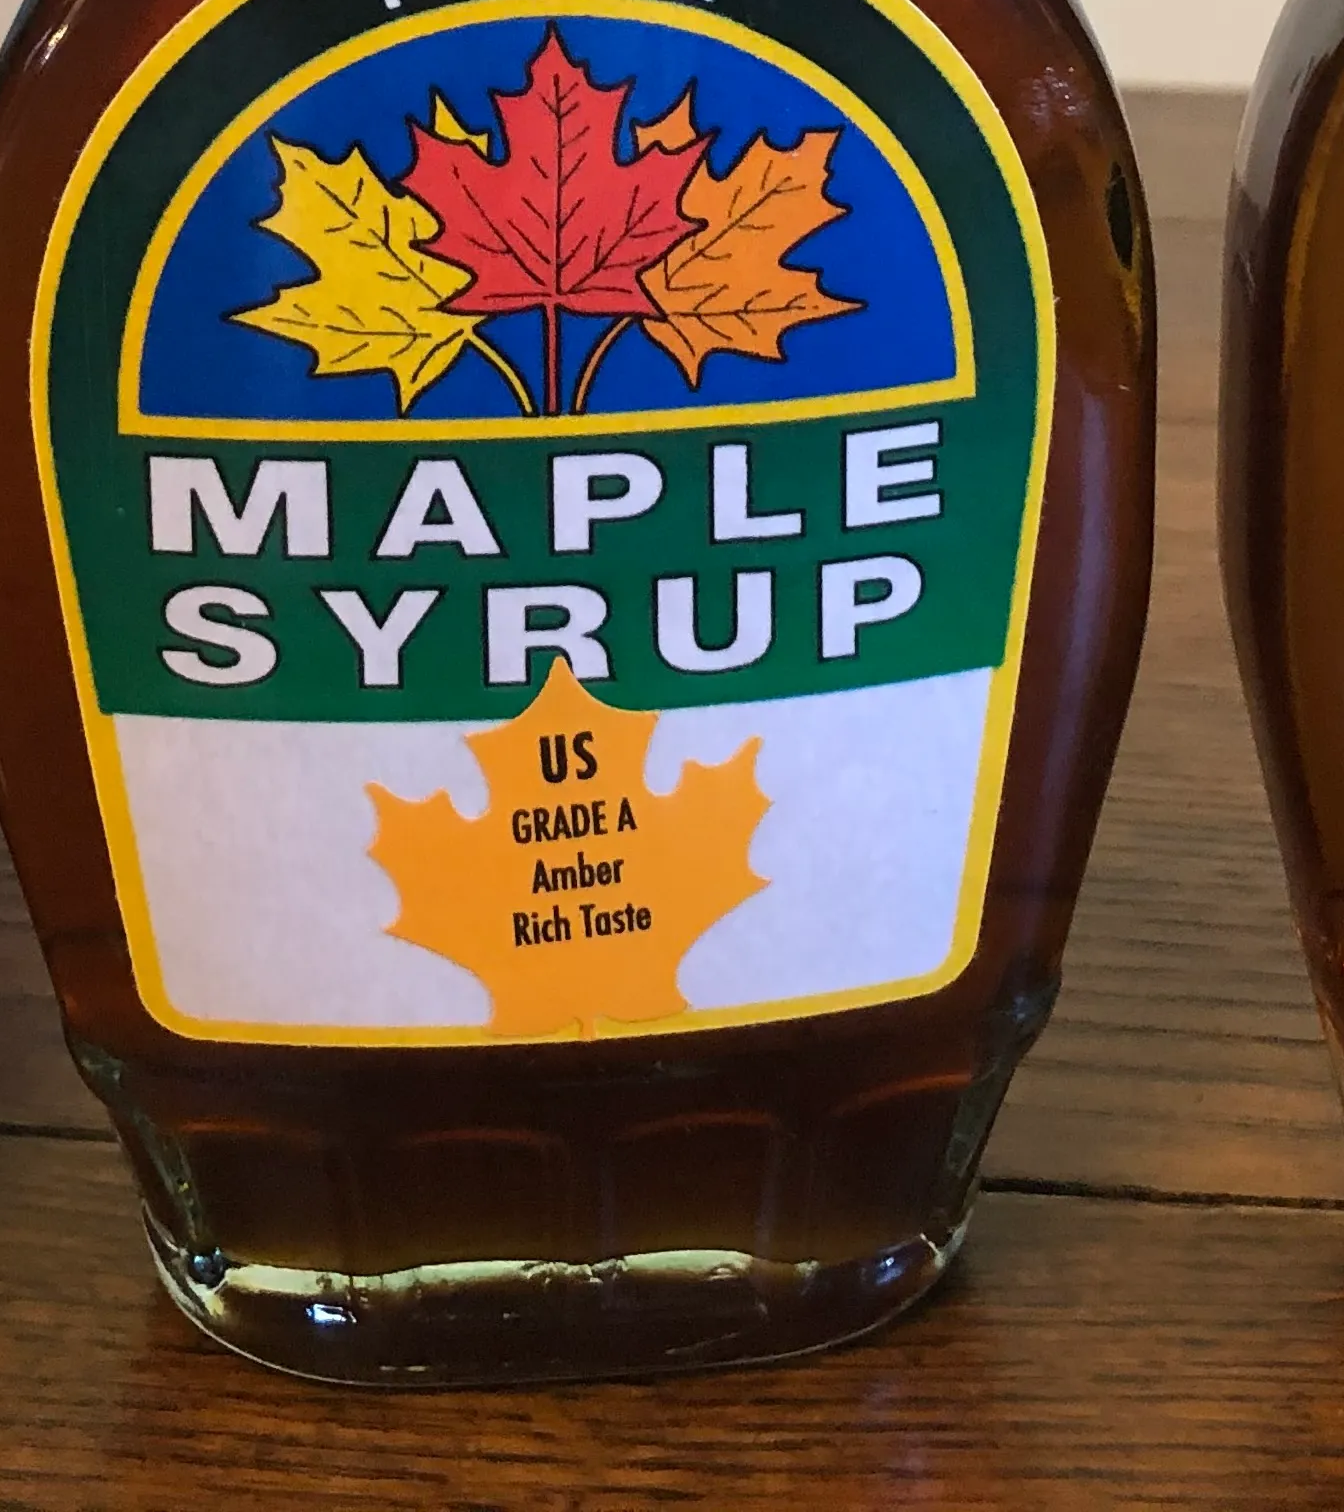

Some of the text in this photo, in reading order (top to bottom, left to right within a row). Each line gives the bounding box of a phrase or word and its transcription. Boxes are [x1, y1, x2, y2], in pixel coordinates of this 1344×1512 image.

[146, 419, 943, 558] MAPLE
[160, 553, 925, 687] SYRUP
[540, 731, 598, 784] US
[511, 798, 637, 845] GRADE A
[531, 855, 625, 894] Amber
[513, 904, 653, 948] Rich Taste
